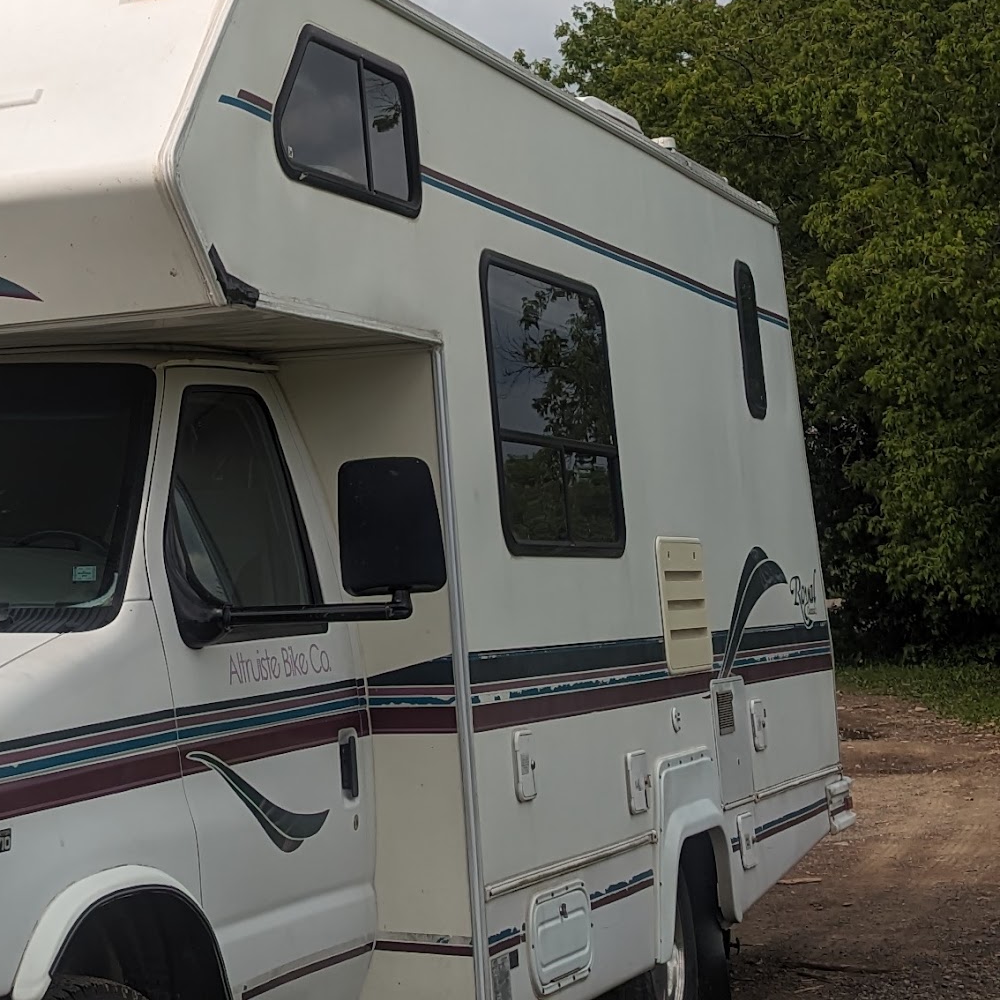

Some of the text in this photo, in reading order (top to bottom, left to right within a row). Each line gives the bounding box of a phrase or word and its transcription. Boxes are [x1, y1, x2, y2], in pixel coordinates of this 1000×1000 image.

[229, 643, 332, 686] Altruiste Bike Co.
